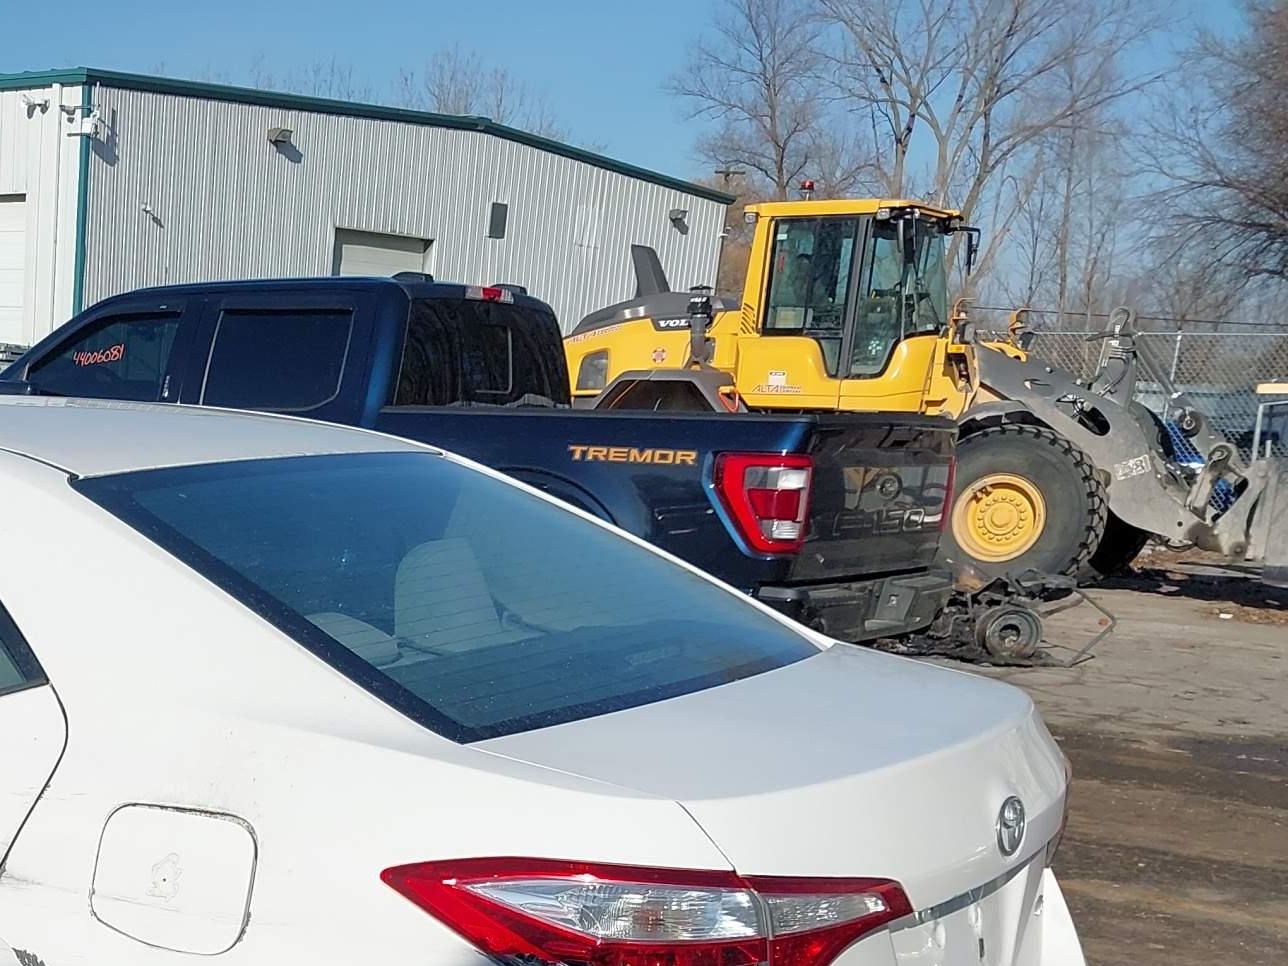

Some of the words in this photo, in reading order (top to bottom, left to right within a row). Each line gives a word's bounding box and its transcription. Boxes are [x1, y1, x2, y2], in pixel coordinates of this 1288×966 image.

[658, 319, 689, 328] VOL
[73, 343, 125, 367] 44006081
[752, 384, 779, 393] ALTA
[568, 445, 698, 465] TREMOR
